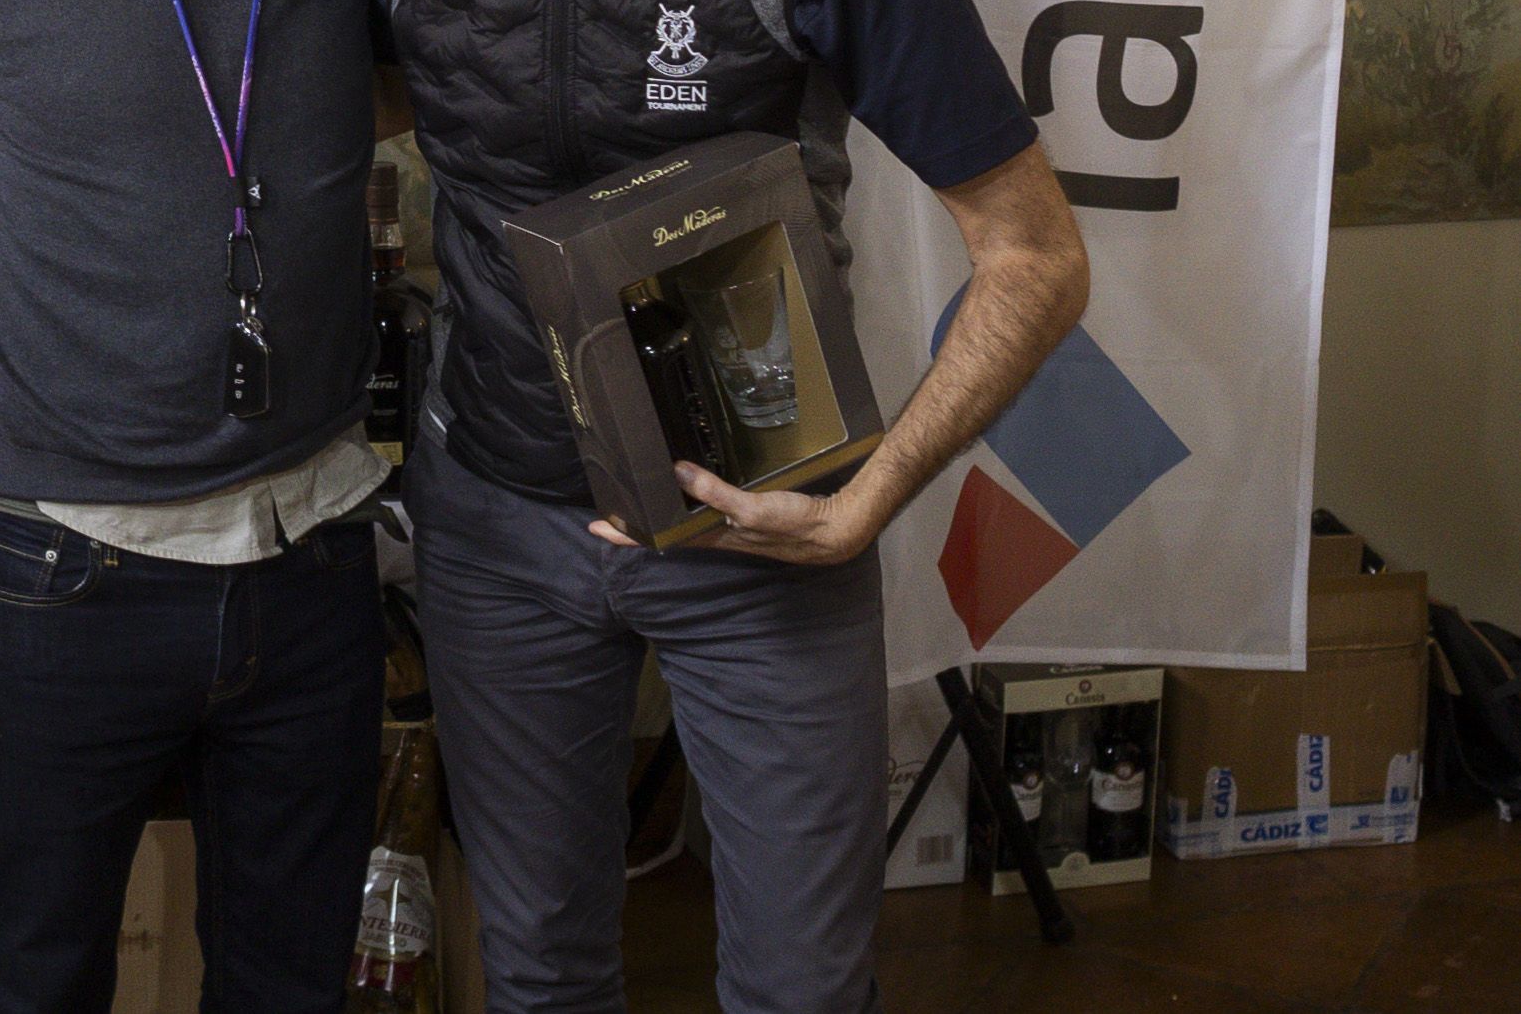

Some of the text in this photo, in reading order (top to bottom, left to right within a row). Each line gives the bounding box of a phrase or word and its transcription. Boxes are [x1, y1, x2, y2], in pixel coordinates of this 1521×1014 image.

[646, 83, 707, 102] EDEN
[647, 101, 708, 112] TOURNAMENT
[1240, 822, 1302, 843] CÁDIZ
